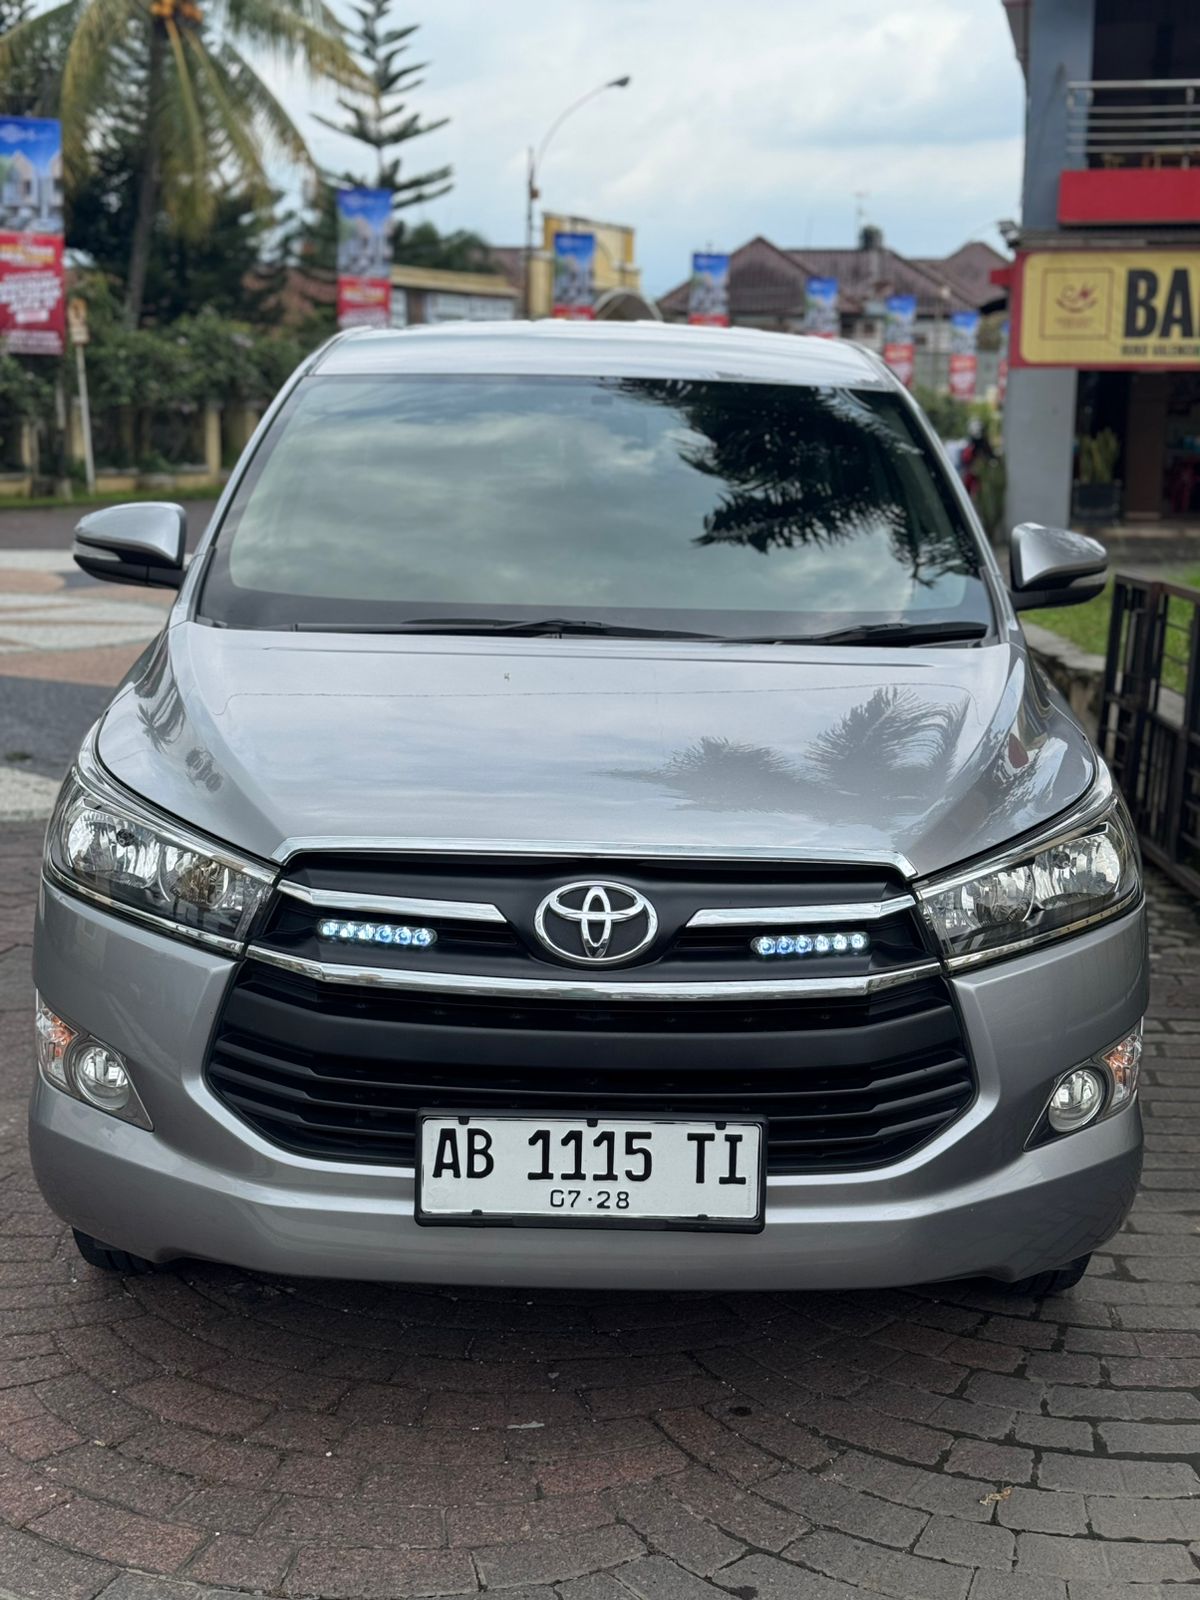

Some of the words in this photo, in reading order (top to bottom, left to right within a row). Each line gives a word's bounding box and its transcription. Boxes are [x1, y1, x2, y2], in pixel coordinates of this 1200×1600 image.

[1124, 268, 1200, 338] BA
[432, 1127, 495, 1179] AB
[528, 1129, 653, 1182] 1115
[687, 1132, 747, 1185] TI
